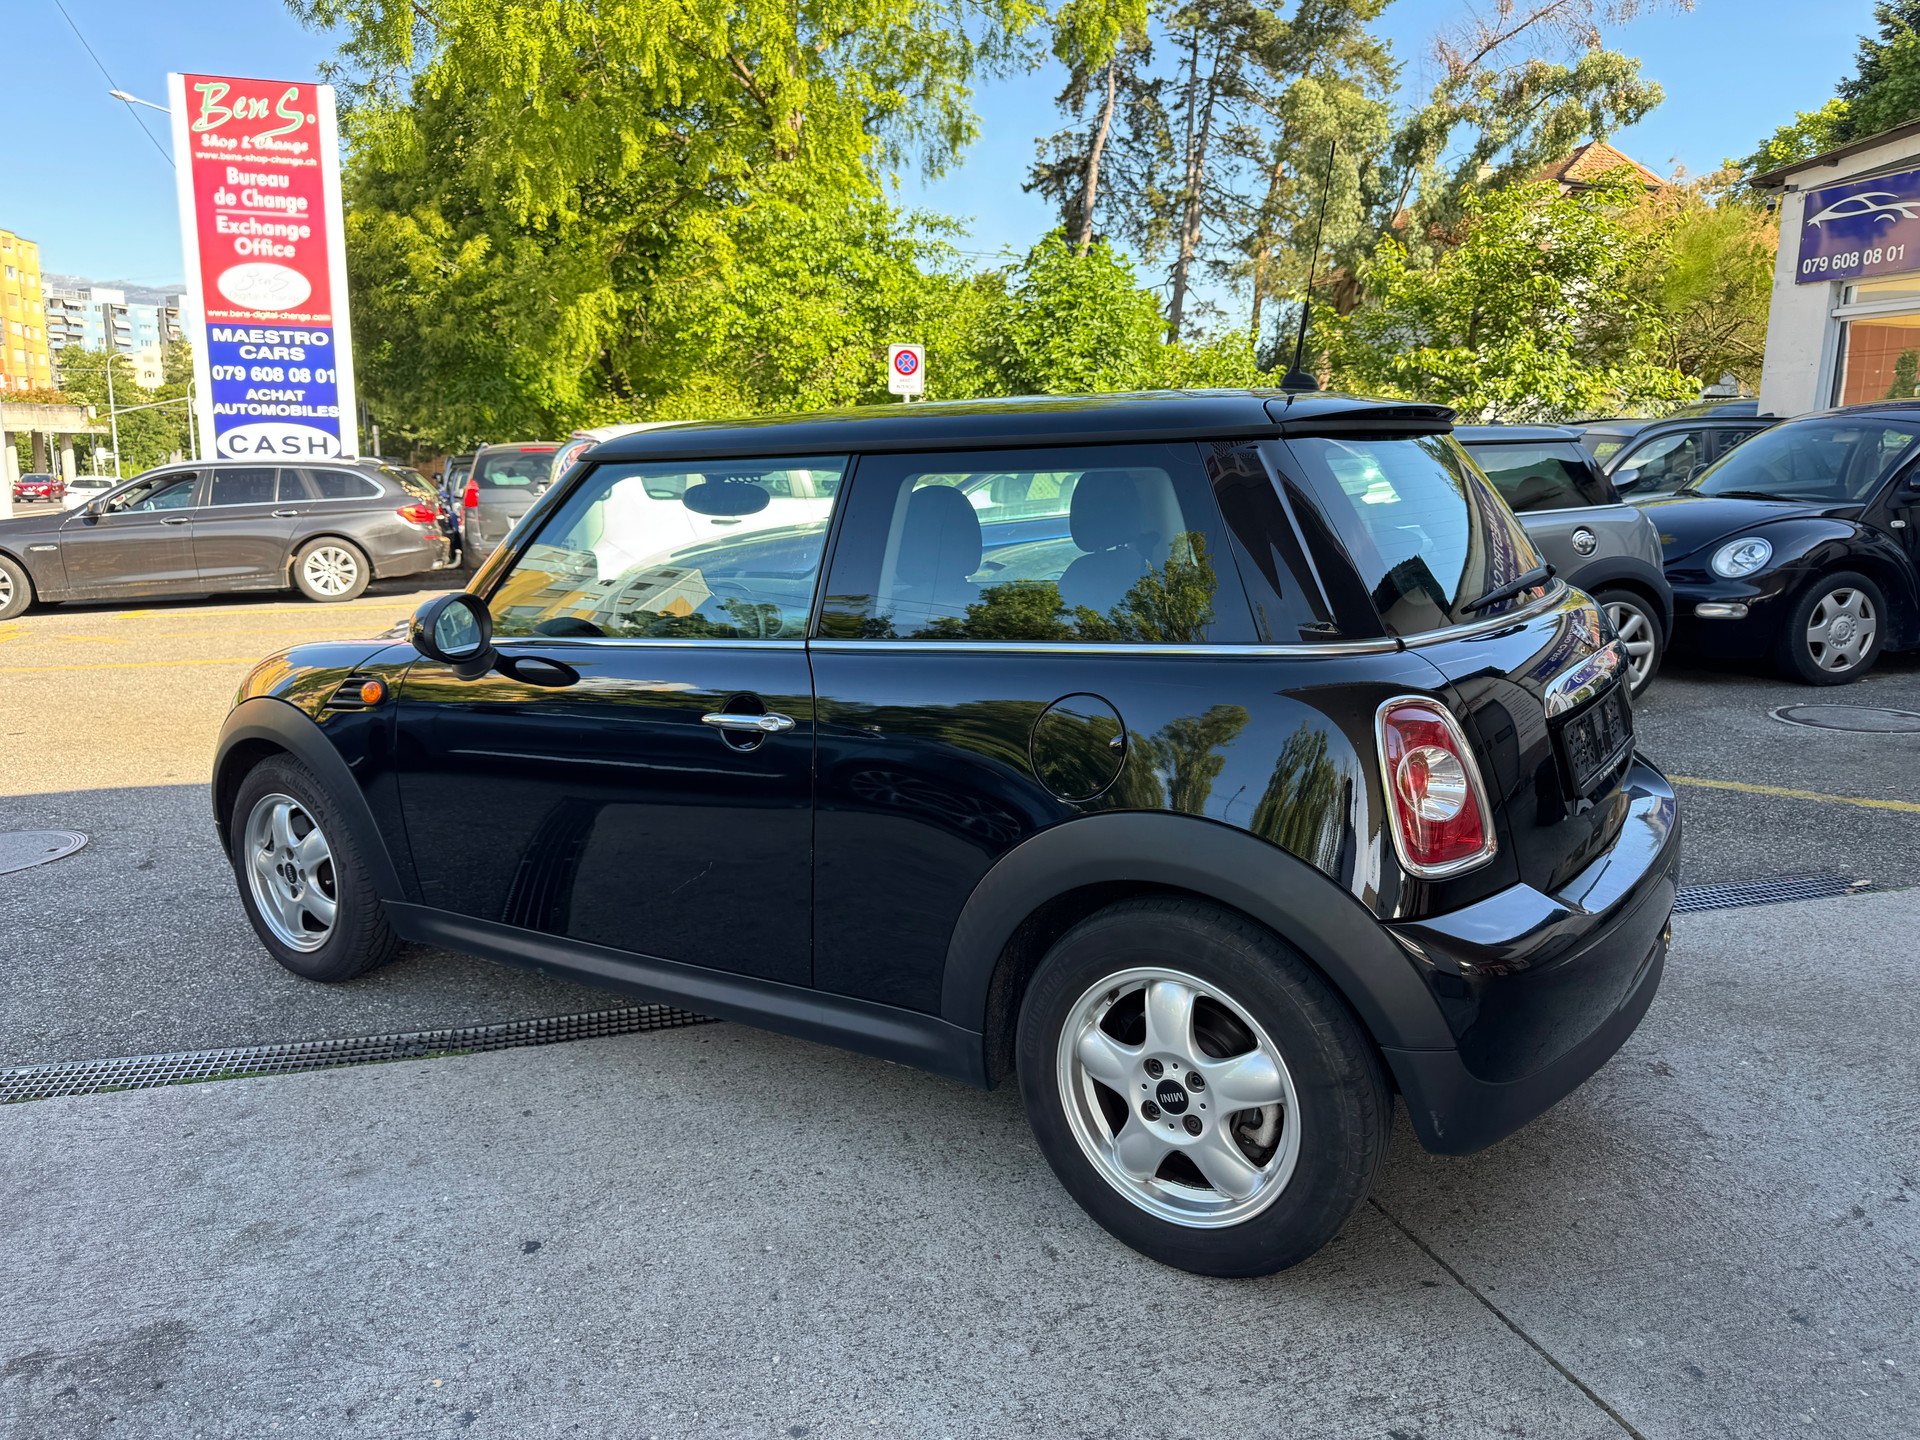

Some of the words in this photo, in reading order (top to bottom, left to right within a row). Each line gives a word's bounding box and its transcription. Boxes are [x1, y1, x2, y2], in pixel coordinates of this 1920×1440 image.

[191, 82, 269, 132] Ben
[201, 133, 238, 150] Shop
[241, 135, 252, 149] &
[254, 136, 309, 155] Change
[195, 151, 318, 167] www.bens-shop-change.ch
[226, 166, 290, 188] Bureau
[213, 186, 237, 206] de
[241, 188, 308, 214] Change
[215, 215, 311, 242] Exchange
[233, 236, 296, 258] Office
[1802, 256, 1829, 274] 079
[1832, 251, 1859, 270] 608
[1863, 248, 1882, 265] 08
[1886, 244, 1905, 261] 01
[207, 309, 331, 322] www.bens-digital-change.com
[212, 328, 329, 346] MAESTRO
[239, 345, 306, 361] CARS
[212, 365, 246, 381] 079
[250, 367, 284, 383] 608
[288, 368, 312, 383] 08
[315, 369, 336, 384] 01
[245, 388, 306, 402] ACHAT
[213, 403, 340, 418] AUTOMOBILES
[228, 434, 329, 455] CASH
[285, 775, 329, 829] UNIROYAL
[1022, 961, 1068, 1059] Continental
[1159, 1091, 1185, 1103] MINI
